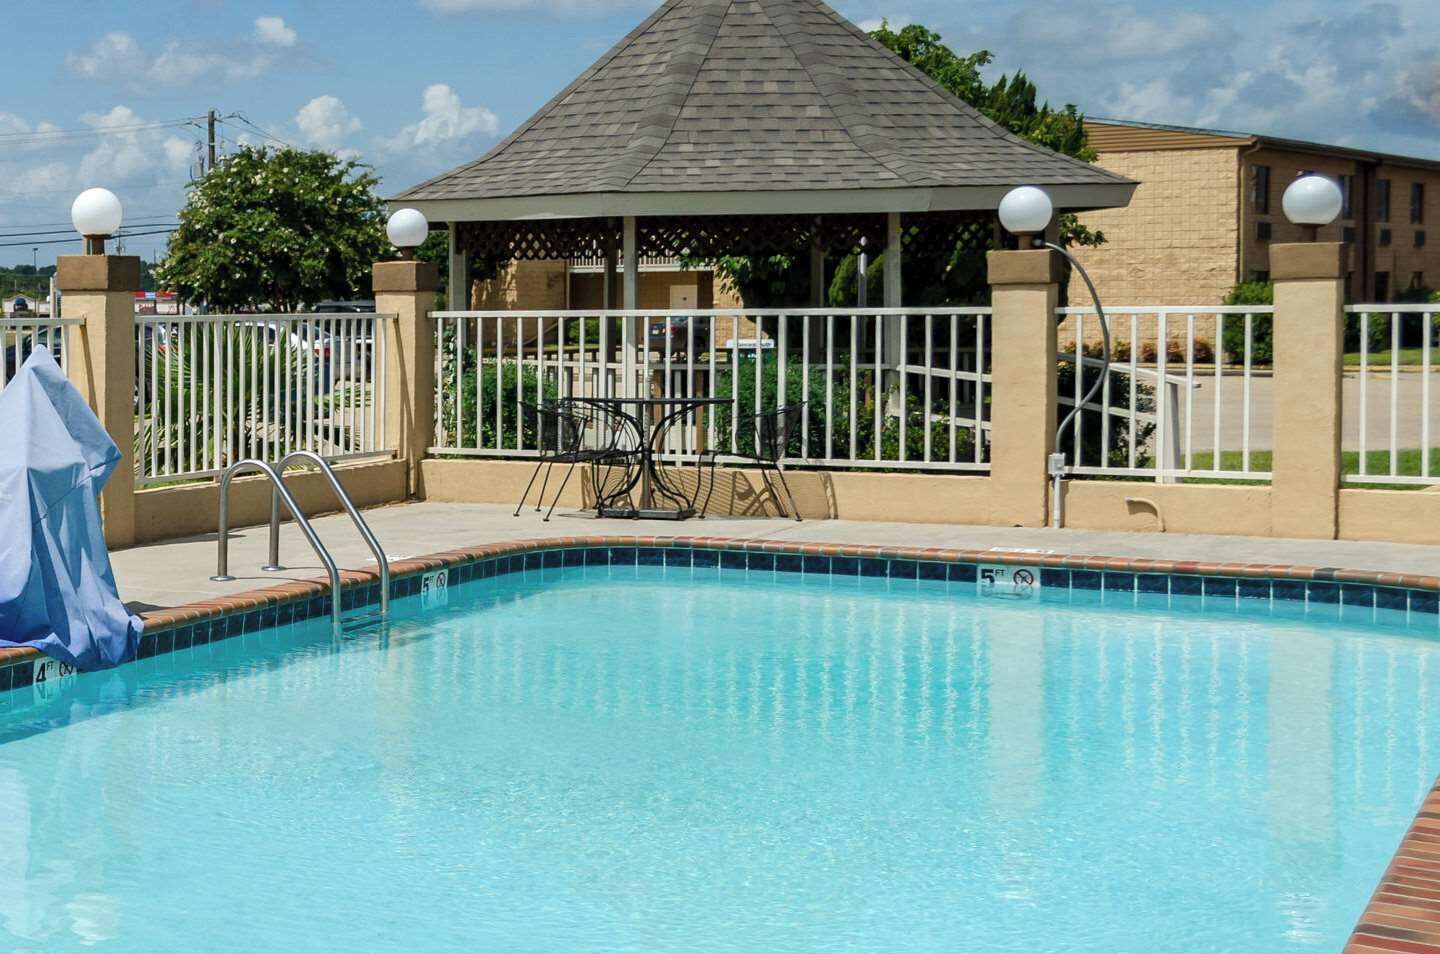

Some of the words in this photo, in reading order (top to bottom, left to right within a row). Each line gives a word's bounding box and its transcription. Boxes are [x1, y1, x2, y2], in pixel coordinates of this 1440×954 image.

[423, 576, 430, 592] 5
[981, 568, 995, 584] 5
[36, 662, 47, 682] 4
[47, 661, 55, 670] FT
